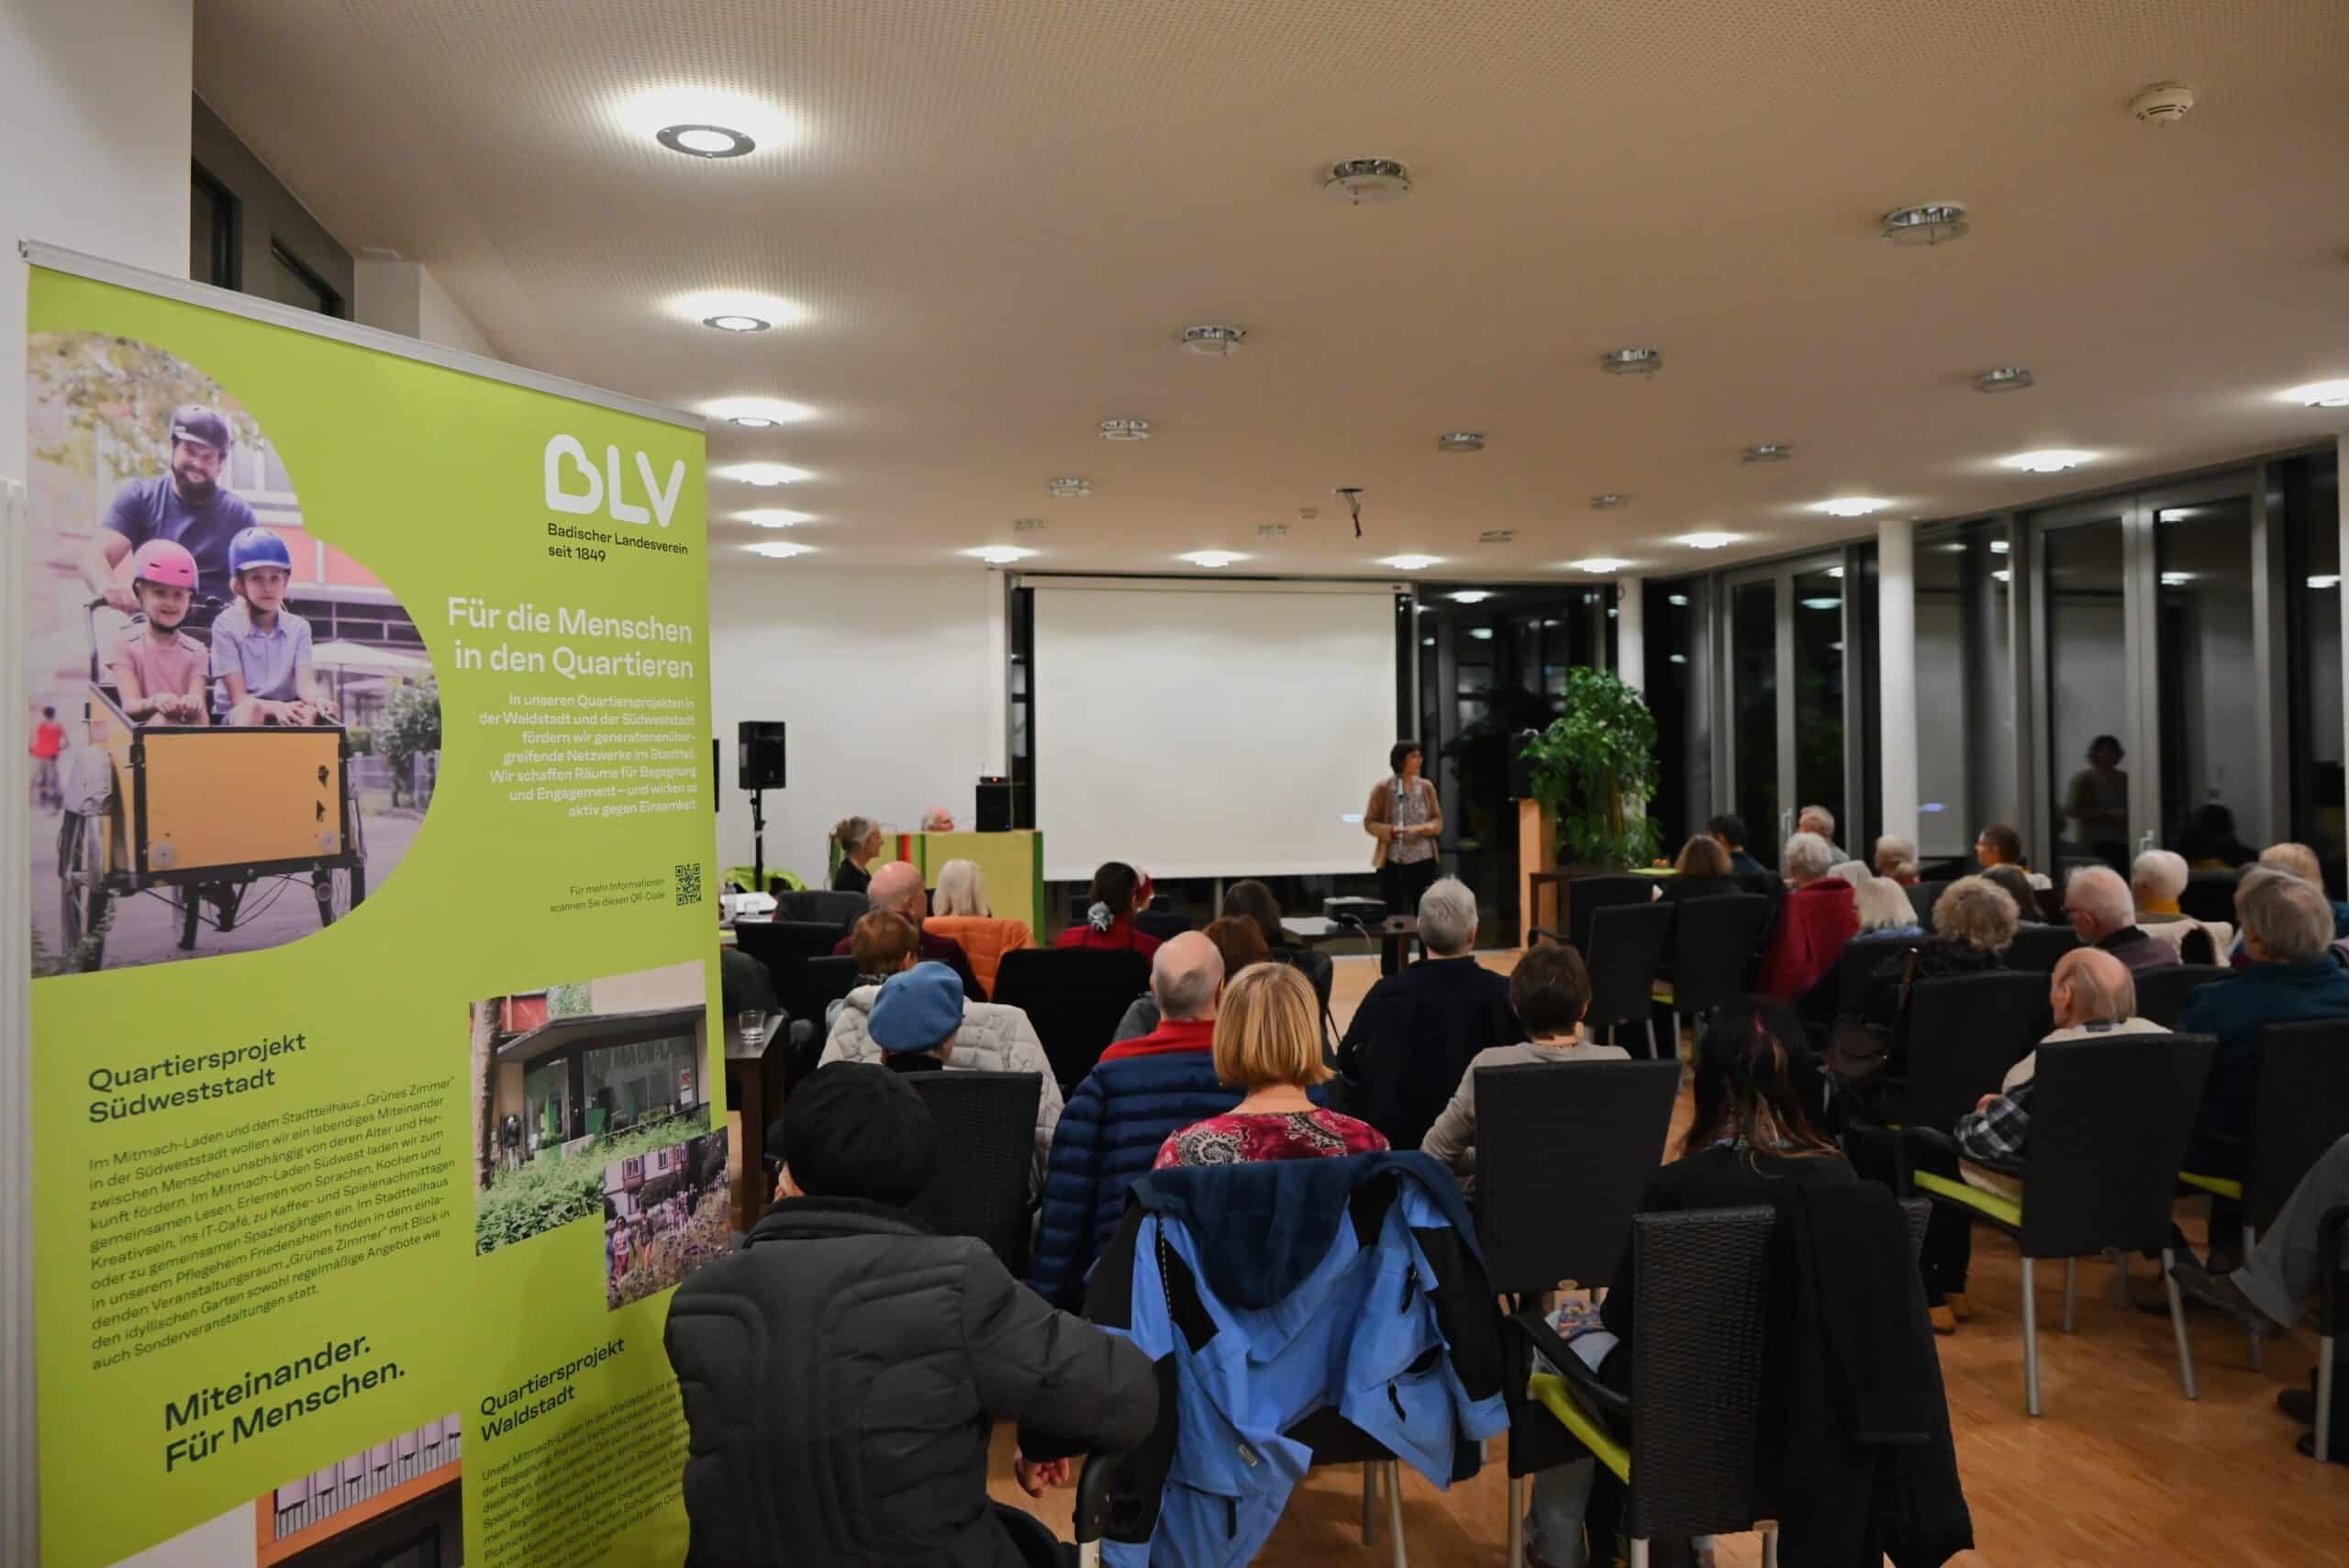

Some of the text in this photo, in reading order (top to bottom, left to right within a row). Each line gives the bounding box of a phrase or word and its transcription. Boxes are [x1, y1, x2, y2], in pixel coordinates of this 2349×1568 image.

[544, 433, 685, 528] BLV
[548, 523, 688, 554] Badischer Landesverein
[549, 546, 606, 562] seit 1849
[448, 597, 692, 643] Für die Menschen
[455, 639, 693, 680] in den Quartieren
[479, 713, 501, 725] der
[503, 712, 571, 725] Waldstadt
[573, 713, 597, 725] und
[600, 714, 619, 725] der
[509, 695, 521, 706] In
[525, 697, 574, 706] unseren
[503, 751, 565, 765] greifende
[568, 750, 633, 762] Netzwerke
[636, 749, 648, 760] im
[522, 731, 570, 743] fördern
[573, 732, 591, 742] wir
[490, 771, 514, 783] Wir
[517, 769, 573, 783] schaffen
[575, 768, 618, 779] Räume
[621, 767, 639, 778] für
[509, 788, 533, 800] und
[537, 785, 616, 802] Engagement
[629, 784, 648, 795] und
[651, 784, 684, 794] wirken
[569, 805, 599, 817] aktiv
[603, 805, 637, 817] gegen
[88, 1032, 306, 1091] Quartiersprojekt
[88, 1068, 276, 1123] Südweststadt
[89, 1159, 109, 1171] Im
[113, 1131, 224, 1165] Mitmach-Laden
[227, 1123, 250, 1139] und
[252, 1118, 279, 1132] dem
[282, 1100, 359, 1125] Stadtteilhaus
[89, 1097, 443, 1190] in der Südweststadt wollen wir ein lebendiges Miteinander
[89, 1115, 441, 1211] zwischen Menschen unabhängig von deren Alter und Her-
[90, 1210, 128, 1231] kunft
[191, 1192, 207, 1204] Im
[212, 1163, 309, 1197] Mitmach-Laden
[314, 1149, 363, 1170] Südwest
[367, 1141, 397, 1155] laden
[401, 1136, 417, 1148] wir
[420, 1130, 443, 1143] zum
[90, 1216, 191, 1253] gemeinsamen
[238, 1188, 287, 1209] Erlernen
[291, 1181, 311, 1194] von
[375, 1153, 417, 1171] Kochen
[420, 1144, 441, 1160] und
[179, 1232, 198, 1244] ins
[253, 1211, 267, 1224] zu
[270, 1200, 315, 1218] Kaffee-
[317, 1188, 340, 1204] und
[343, 1160, 455, 1196] Spielenachmittagen
[90, 1273, 125, 1290] oder
[128, 1269, 145, 1280] zu
[149, 1239, 240, 1277] gemeinsamen
[243, 1210, 331, 1244] Spaziergängen
[357, 1199, 372, 1211] Im
[374, 1178, 448, 1205] Stadtteilhaus
[91, 1196, 444, 1311] in unserem Pflegeheim Friedensheim finden in dem einla-
[91, 1306, 149, 1330] denden
[152, 1262, 283, 1311] Veranstaltungsraum
[389, 1221, 408, 1234] mit
[411, 1211, 438, 1229] Blick
[440, 1210, 450, 1219] in
[92, 1229, 440, 1351] den idyllischen Garten sowohl regelmäßige Angebote wie
[93, 1350, 130, 1371] auch
[134, 1296, 284, 1357] Sonderveranstaltungen
[165, 1337, 371, 1431] Miteinander.
[481, 1337, 625, 1416] Quartiersprojekt
[166, 1360, 406, 1473] Für Menschen.
[481, 1385, 575, 1442] Waldstadt
